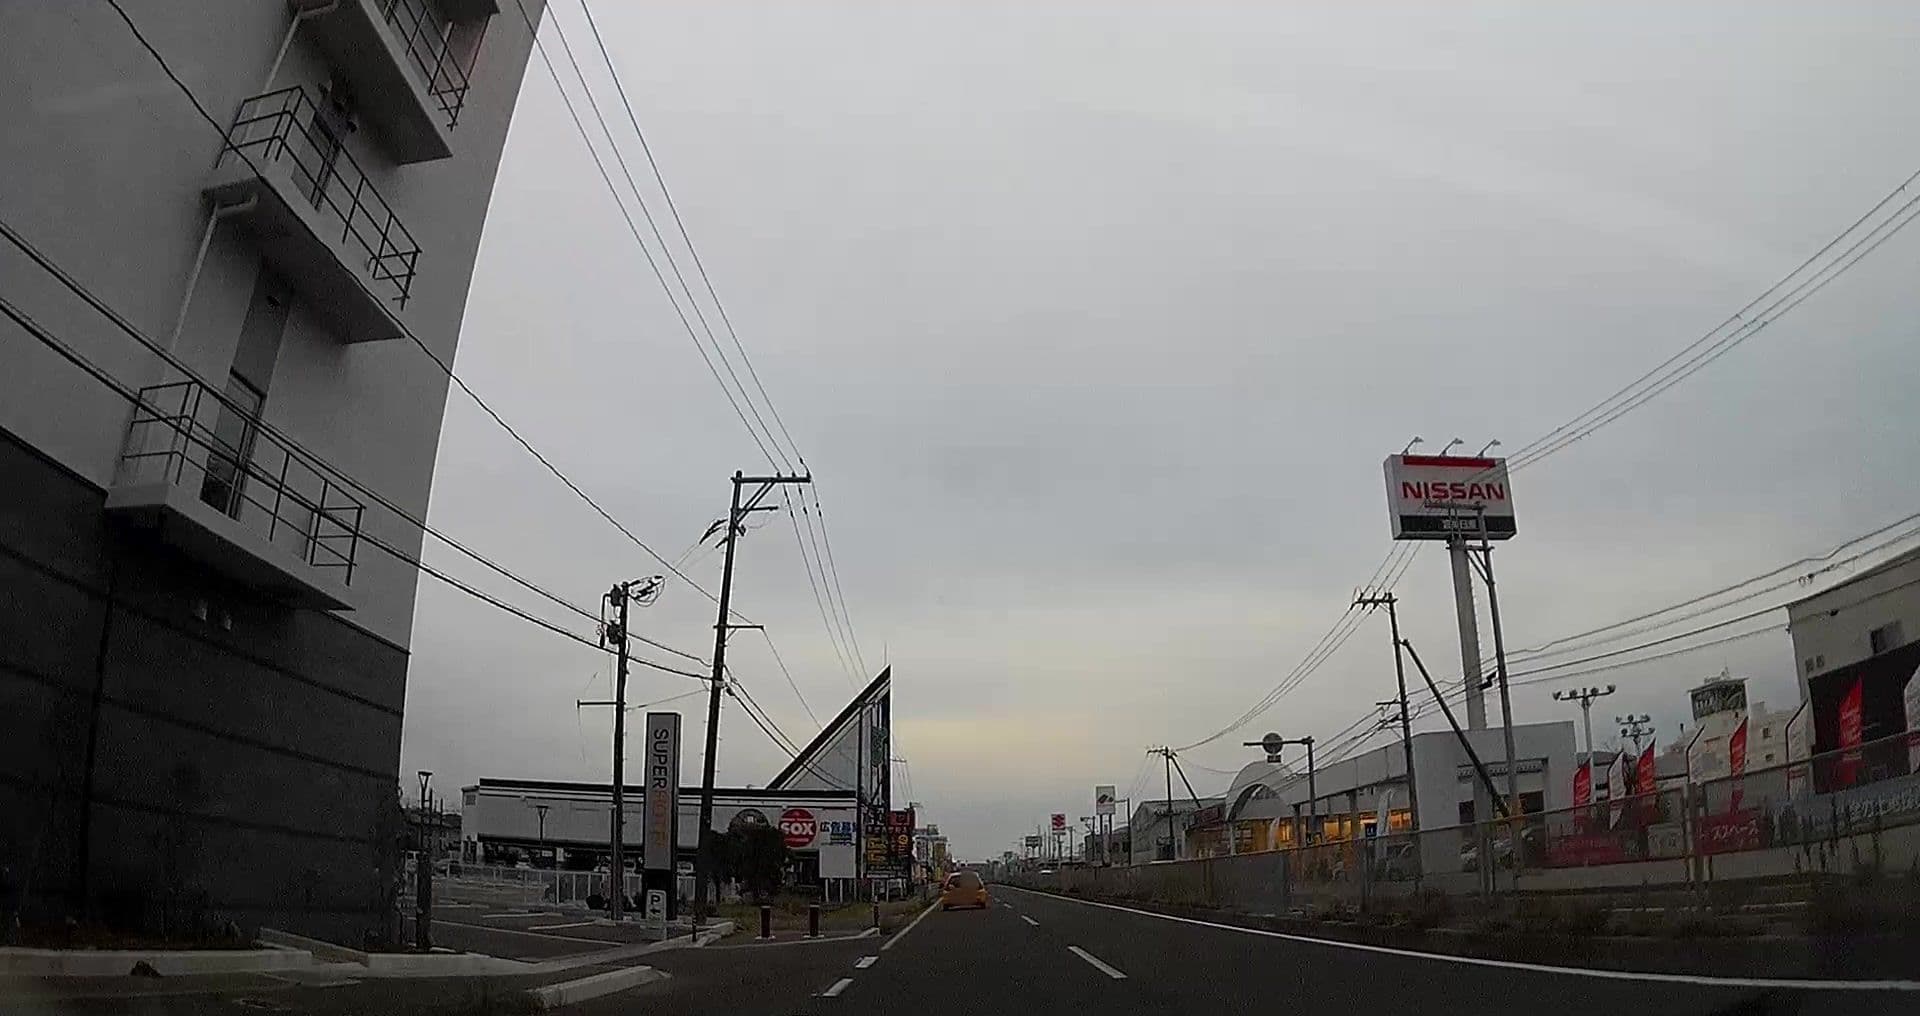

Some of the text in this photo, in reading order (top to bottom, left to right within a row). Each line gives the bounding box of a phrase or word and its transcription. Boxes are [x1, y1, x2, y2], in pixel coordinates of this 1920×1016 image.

[1402, 481, 1505, 500] NISSAN
[652, 729, 669, 789] SUPER
[780, 822, 814, 835] SOX
[651, 894, 661, 906] P
